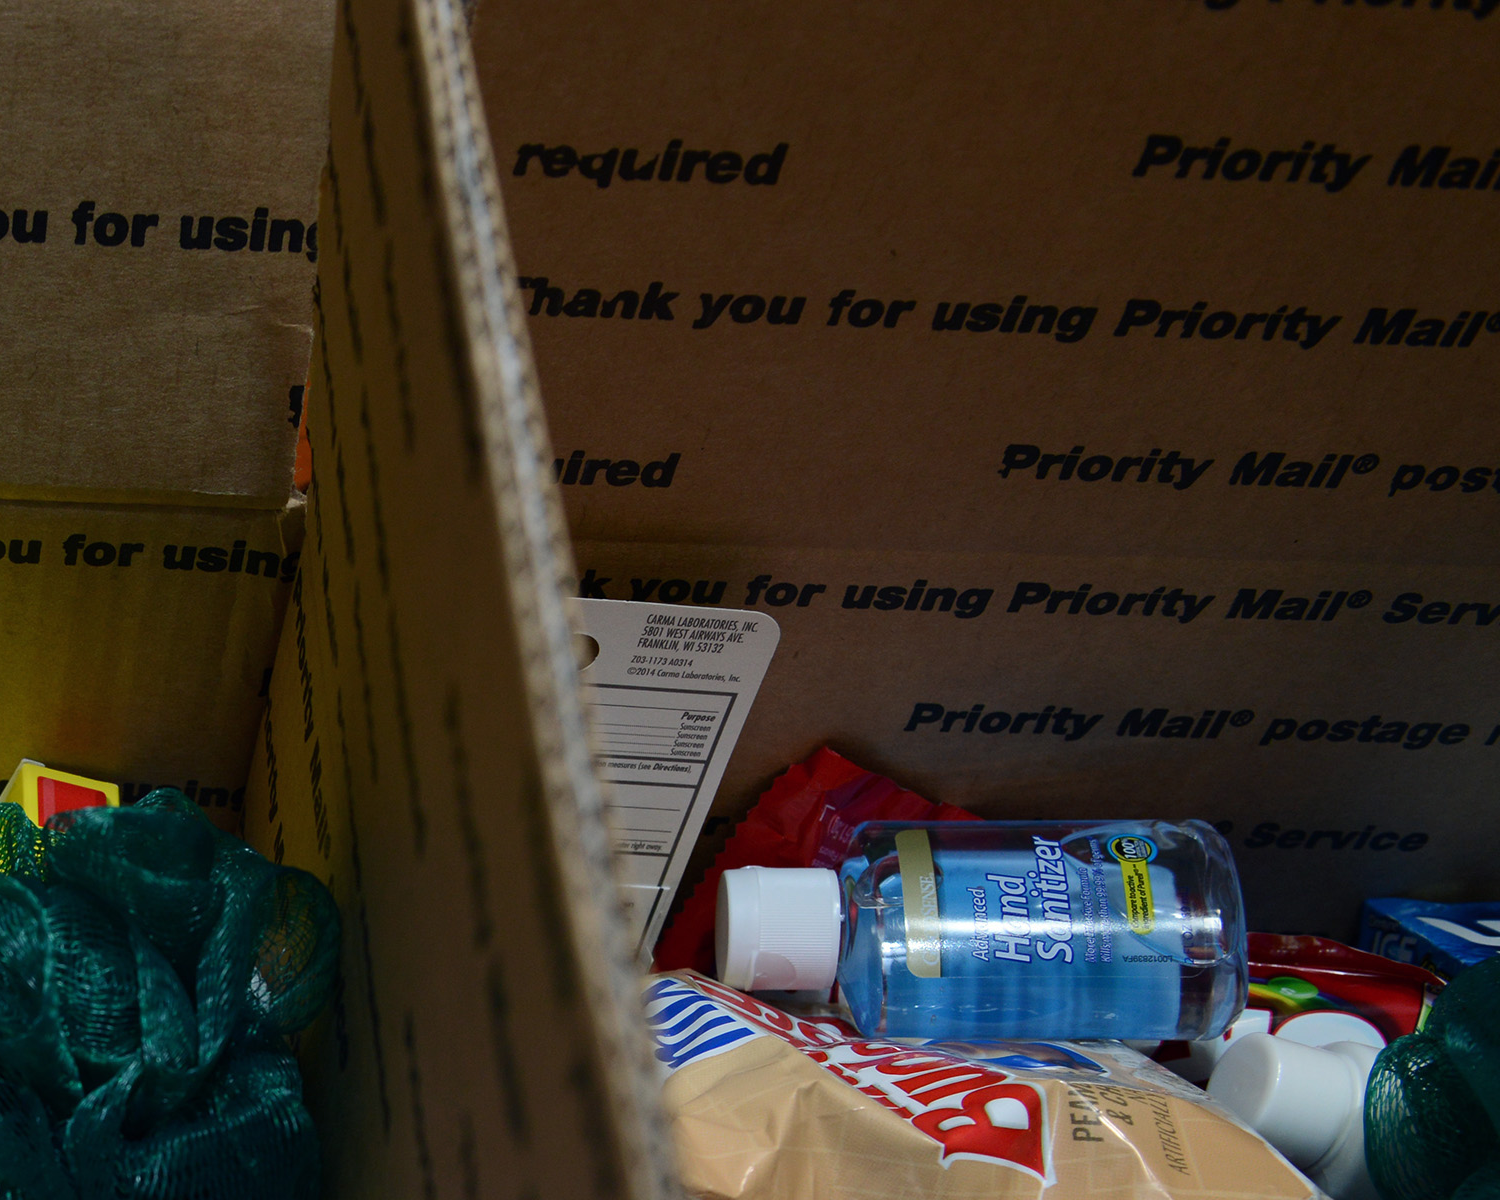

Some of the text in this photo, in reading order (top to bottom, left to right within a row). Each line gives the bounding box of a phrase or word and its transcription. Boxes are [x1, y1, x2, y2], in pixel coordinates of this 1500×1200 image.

[513, 139, 788, 188] required
[1133, 134, 1374, 192] Priority
[72, 201, 158, 247] for
[693, 291, 806, 329] you
[827, 289, 916, 328] for
[932, 295, 1097, 343] using
[1113, 298, 1342, 349] Priority
[998, 444, 1214, 490] Priority
[63, 534, 144, 567] for
[744, 574, 827, 607] for
[840, 579, 995, 618] using
[1007, 580, 1215, 623] Priority
[646, 613, 675, 627] CARMA
[677, 616, 739, 632] LABORATORIES,
[666, 627, 689, 639] WEST
[689, 629, 726, 642] AIRWAYS
[726, 632, 745, 643] AVE.
[637, 637, 725, 654] FRANKLIN, WI 53132
[656, 669, 726, 683] Carma Laboratories,
[680, 711, 716, 723] Purpose
[680, 722, 711, 732] Sunscreen
[904, 702, 1104, 742] Priority
[1260, 712, 1471, 750] postage
[673, 739, 704, 749] Sunscreen
[676, 731, 708, 740] Sunscreen
[670, 748, 701, 757] Sunscreen
[1244, 822, 1429, 852] Service
[1034, 834, 1075, 965] Sanitizer
[986, 872, 1033, 965] Hand
